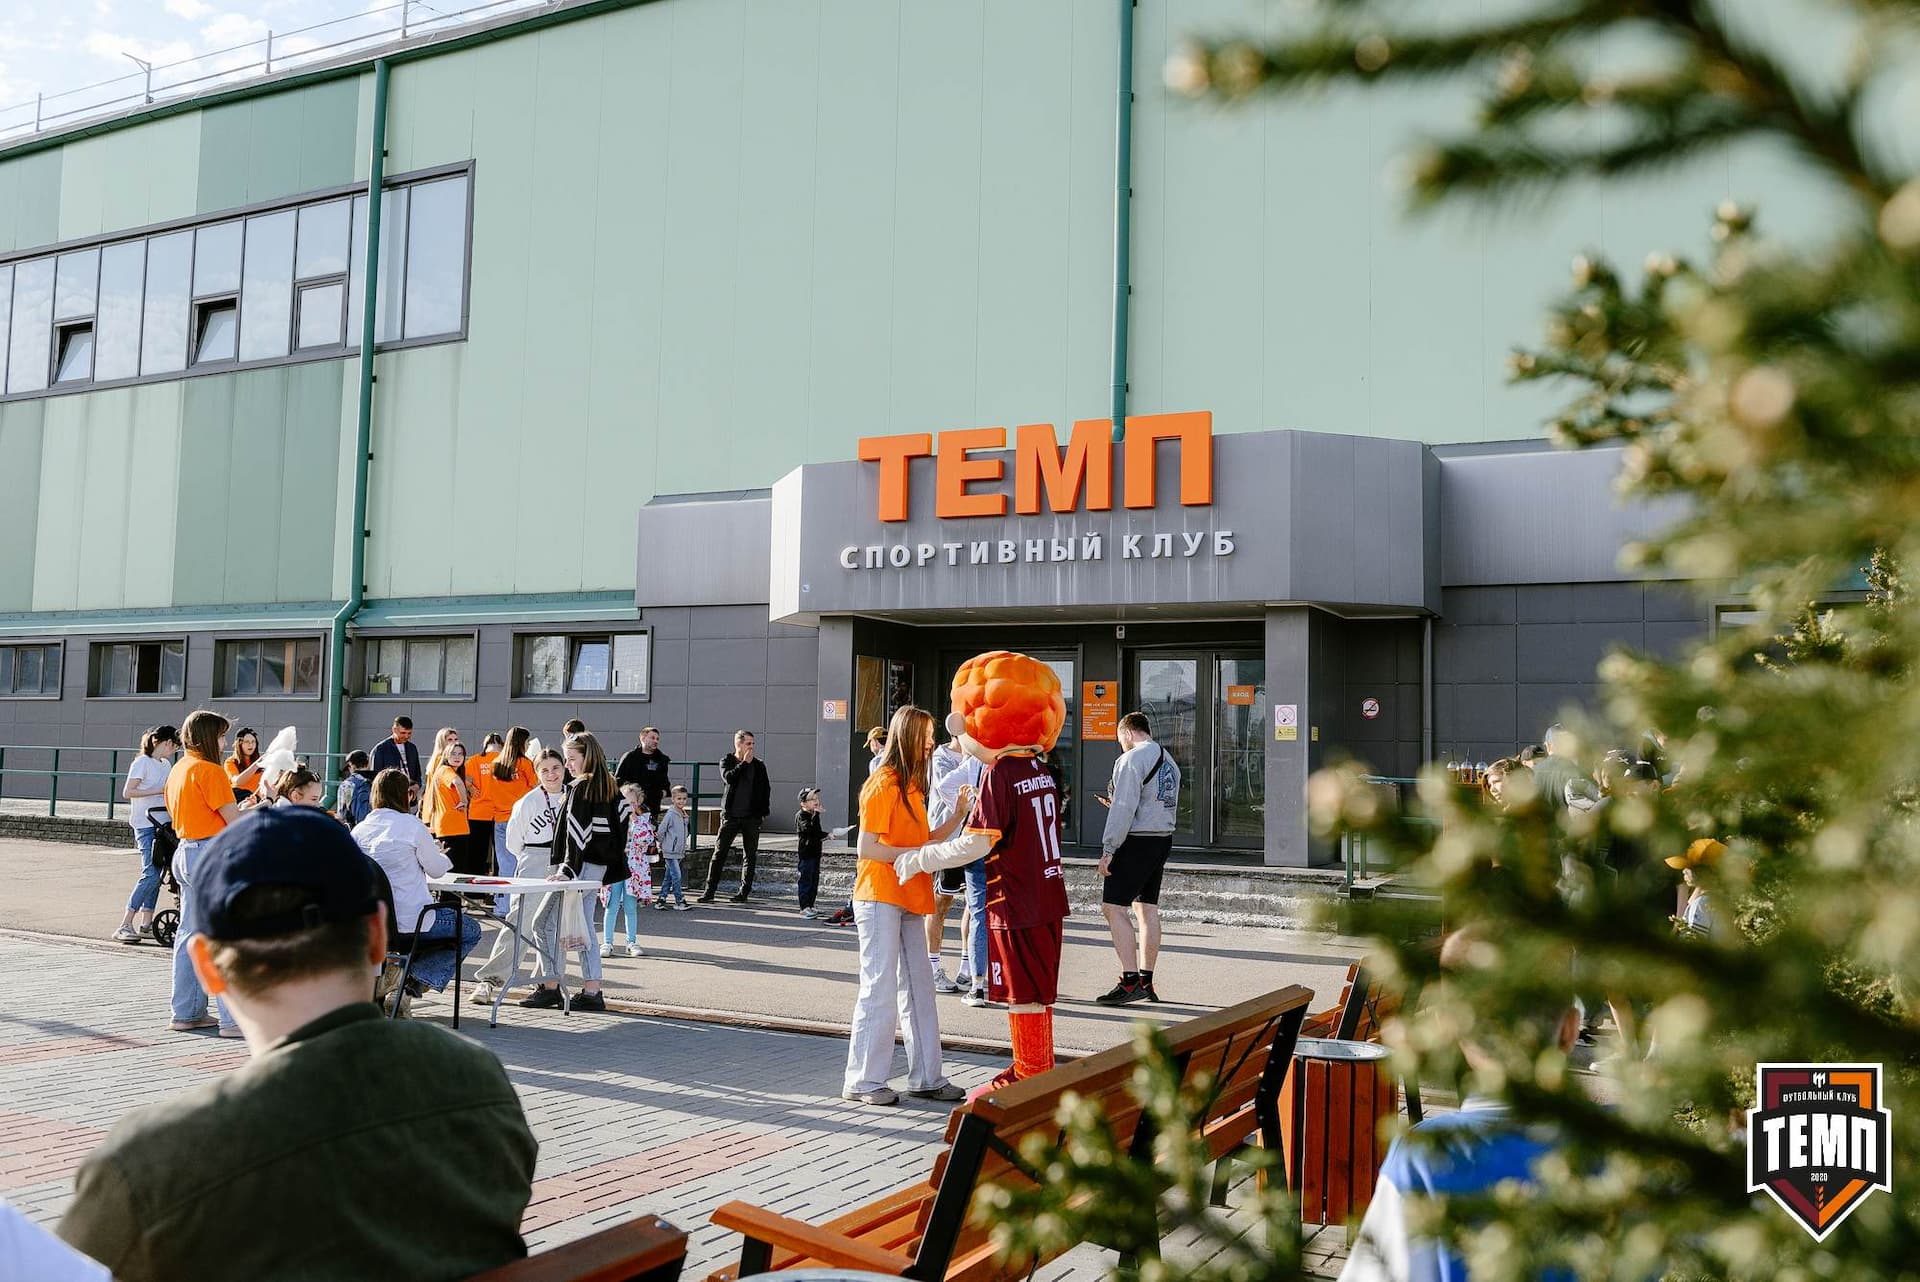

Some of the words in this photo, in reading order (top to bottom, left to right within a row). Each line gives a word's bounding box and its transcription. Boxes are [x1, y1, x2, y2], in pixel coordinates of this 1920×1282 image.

[857, 411, 1213, 523] ТЕМП
[840, 531, 1102, 570] СПОРТИВНЫЙ
[1122, 530, 1236, 560] КЛУБ
[530, 807, 557, 835] JUST
[1031, 793, 1061, 862] 12
[991, 961, 1002, 985] 12
